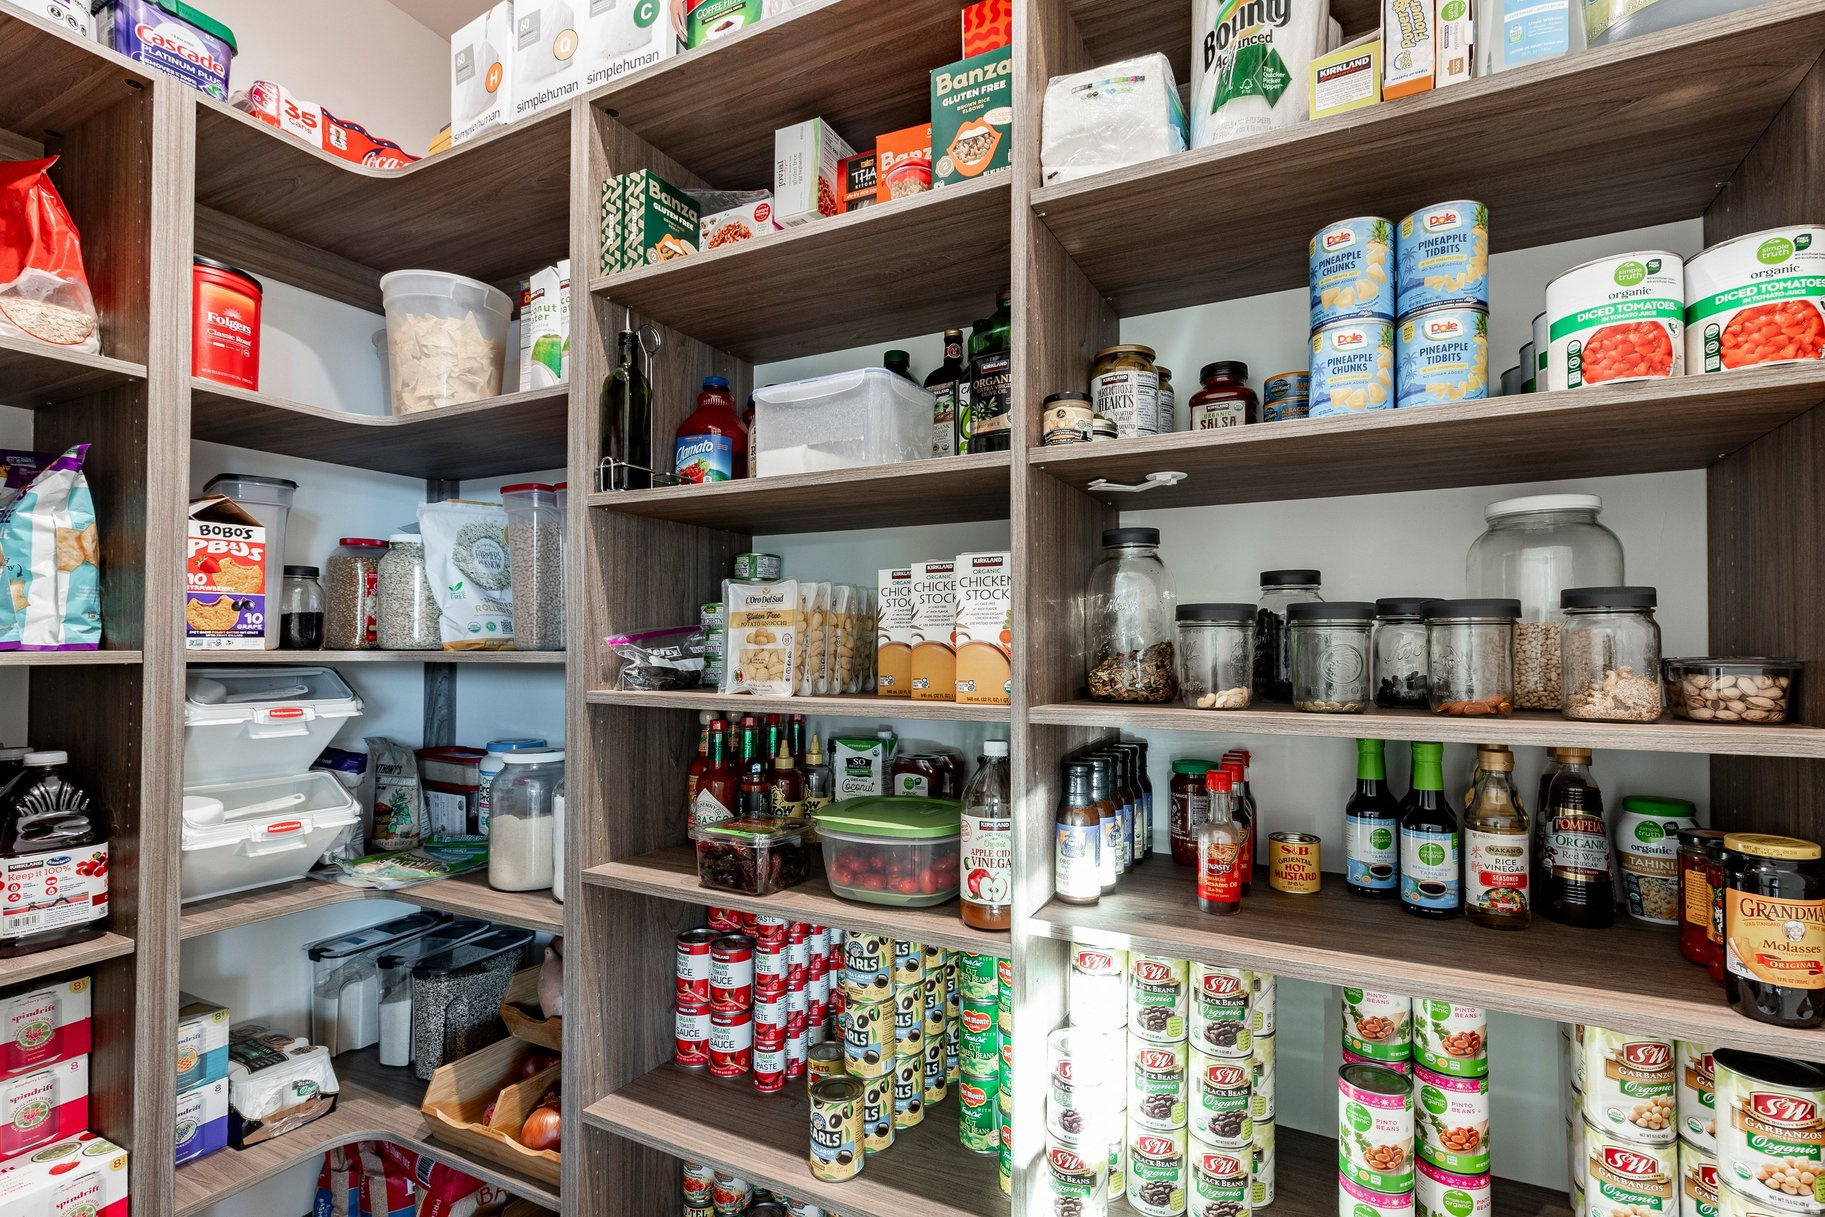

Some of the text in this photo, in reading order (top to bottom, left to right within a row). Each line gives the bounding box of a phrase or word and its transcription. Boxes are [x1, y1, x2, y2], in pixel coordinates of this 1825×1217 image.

[696, 2, 722, 19] COFFEE
[137, 25, 224, 77] Cascade
[142, 43, 196, 75] PLATINUM
[198, 70, 222, 86] PLUS
[586, 49, 659, 85] simplehuman
[1319, 57, 1370, 78] KIRKLAND
[489, 70, 498, 85] H
[935, 57, 1012, 96] Banza
[516, 79, 579, 113] simplehuman
[942, 80, 1006, 107] GLUTEN FREE
[957, 103, 976, 111] BROWN
[963, 104, 984, 113] ELBOWS
[284, 99, 318, 130] 35
[289, 117, 312, 135] Cans
[453, 109, 501, 141] simplehuman
[851, 168, 877, 183] THA
[648, 178, 698, 223] Banza
[653, 202, 678, 222] GLUTEN
[678, 215, 694, 231] FREE
[1430, 213, 1456, 225] Dole
[1327, 231, 1350, 245] Dole
[1418, 233, 1467, 251] PINEAPPLE
[1425, 244, 1460, 258] TIDBITS
[1762, 244, 1789, 254] simple
[1762, 250, 1790, 259] truth
[1318, 251, 1362, 270] PINEAPPLE
[1322, 260, 1356, 276] CHUNKS
[1618, 268, 1642, 276] simple
[1750, 264, 1800, 279] organic
[1617, 272, 1642, 281] truth
[1608, 287, 1652, 300] organic
[1715, 286, 1758, 305] DICED
[1752, 291, 1784, 301] TOMATO
[1577, 308, 1611, 322] DICED
[1611, 312, 1638, 321] TOMATO
[1639, 310, 1657, 318] JUICE
[207, 312, 251, 335] Folgers
[1431, 322, 1458, 333] Dole
[207, 328, 251, 346] Classic Roast
[1337, 333, 1363, 344] Dole
[1420, 343, 1468, 356] PINEAPPLE
[983, 361, 1008, 370] KIRKLAND
[1327, 353, 1373, 367] PINEAPPLE
[1427, 353, 1461, 365] TIDBITS
[1332, 363, 1368, 375] CHUNKS
[973, 374, 1011, 389] ORGANI
[1098, 394, 1134, 411] HEARTS
[1203, 411, 1232, 419] ORGANIC
[1200, 417, 1237, 430] SALSA
[676, 440, 713, 464] Clamato
[475, 550, 502, 561] FARMERS
[187, 573, 207, 585] 10
[959, 576, 1011, 587] CHICKEN
[914, 581, 956, 592] CHICKE
[772, 594, 783, 603] Sud
[966, 589, 1009, 600] STOCK
[245, 613, 263, 623] 10
[746, 612, 765, 621] Gluten
[853, 758, 865, 766] SO
[842, 779, 874, 794] Coconut
[980, 821, 1009, 829] KIRKLAND
[1555, 818, 1606, 833] POMPEIAN
[1555, 835, 1607, 850] ORGANIC
[971, 849, 993, 857] APPLE
[1281, 845, 1309, 855] S&B
[1631, 844, 1672, 855] organic
[971, 857, 1011, 868] VINEGA
[1278, 857, 1312, 866] ORIENTAL
[1562, 851, 1603, 863] Red Wine
[1629, 856, 1676, 869] TAHINI
[10, 861, 43, 869] KIRKLAND
[1285, 864, 1306, 872] HOT
[1485, 864, 1525, 872] VINEGAR
[8, 872, 34, 881] Keep
[44, 866, 71, 875] 100%
[1274, 870, 1317, 881] MUSTARD
[1491, 874, 1519, 882] SEASONED
[1763, 939, 1821, 954] Molasses
[1137, 962, 1168, 979] S&W
[1207, 976, 1239, 993] S&W
[1223, 999, 1245, 1007] BEANS
[11, 1004, 56, 1023] spindrift
[1200, 1005, 1242, 1017] Organic
[676, 1029, 700, 1038] SAUCE
[710, 1040, 734, 1049] SAUCE
[1141, 1050, 1173, 1067] S&W
[1630, 1046, 1668, 1064] S&W
[1211, 1067, 1243, 1084] S&W
[10, 1083, 53, 1104] spindrift
[1203, 1086, 1248, 1096] BLACK BEANS
[1624, 1081, 1672, 1097] Organic
[969, 1092, 985, 1100] Monte
[1204, 1095, 1246, 1108] Organic
[1758, 1098, 1811, 1121] S&W
[1745, 1118, 1822, 1140] GARBANZOS
[1139, 1138, 1173, 1156] S&W
[1751, 1134, 1818, 1154] Organic
[1156, 1159, 1178, 1167] BEANS
[1204, 1156, 1238, 1173] S&W
[1608, 1152, 1652, 1175] S&W
[1135, 1164, 1176, 1178] Organic
[1067, 1176, 1090, 1185] BEANS
[1221, 1179, 1244, 1187] BEANS
[1598, 1168, 1664, 1192] GARBANZOS
[56, 1185, 100, 1210] spindrift
[1200, 1185, 1241, 1198] Organic
[1603, 1183, 1659, 1205] Organic
[1444, 1201, 1472, 1209] organic
